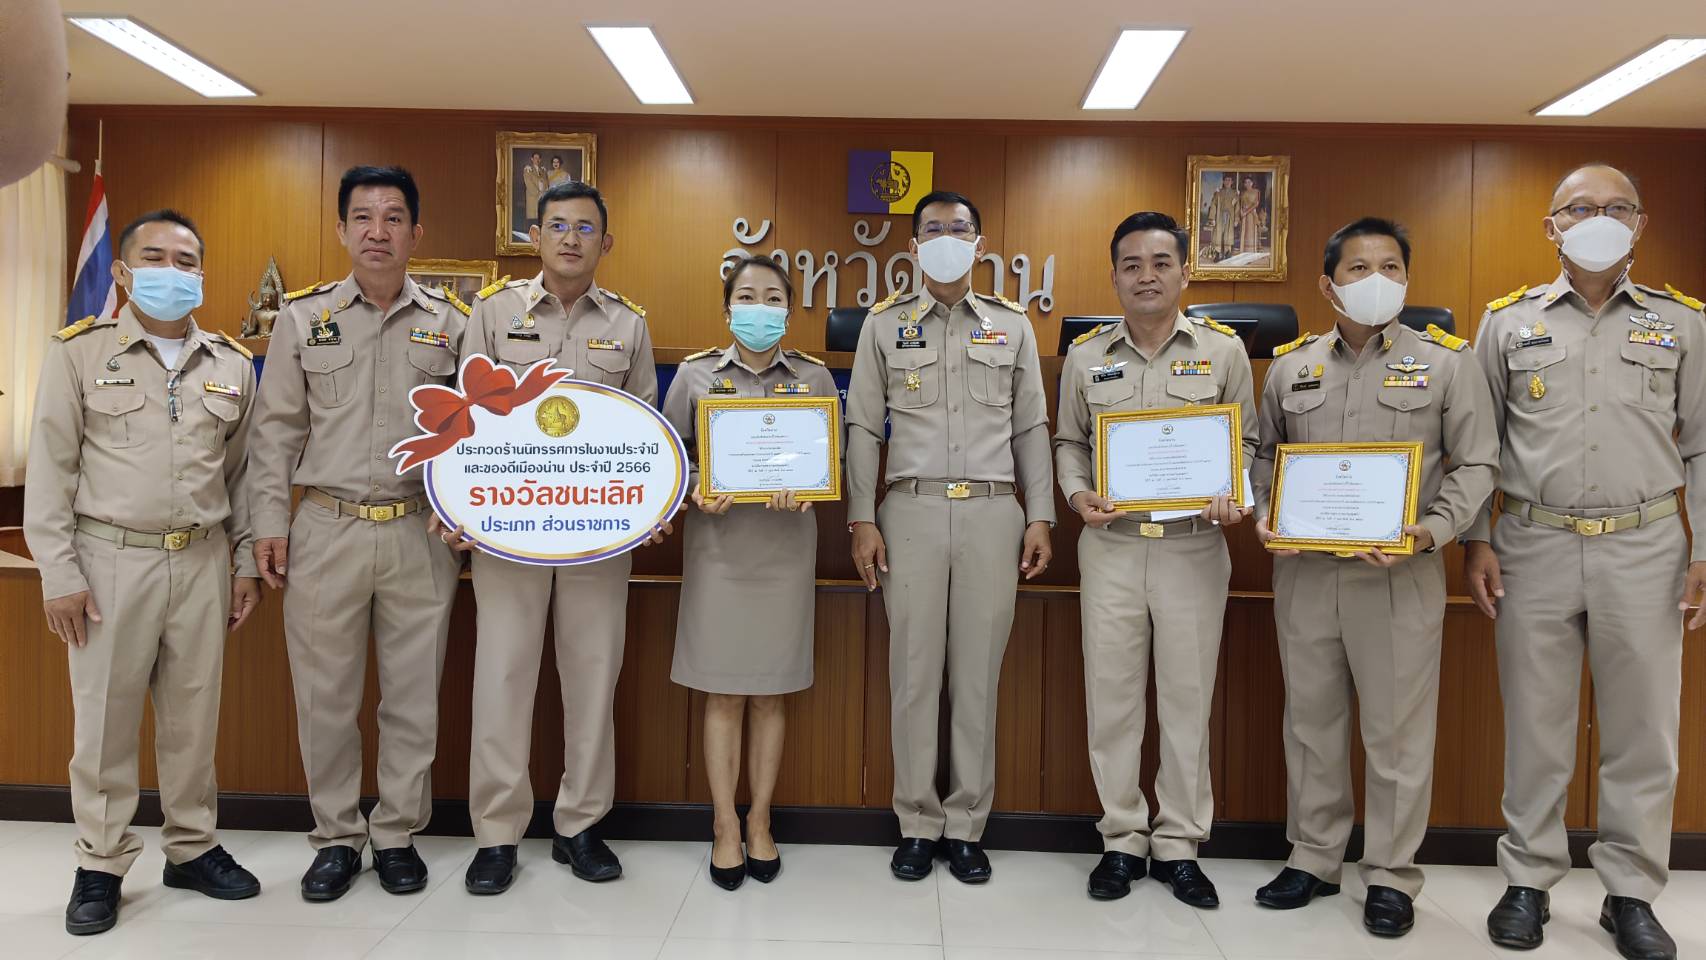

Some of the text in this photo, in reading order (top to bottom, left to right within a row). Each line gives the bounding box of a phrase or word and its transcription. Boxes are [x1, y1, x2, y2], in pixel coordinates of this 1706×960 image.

[464, 461, 651, 473] และของดีเมืองน่าน ประจำปี 2566
[469, 479, 644, 506] รางวัลชนะเลิศ
[481, 515, 631, 532] ประเภท ส่วนราชการ
